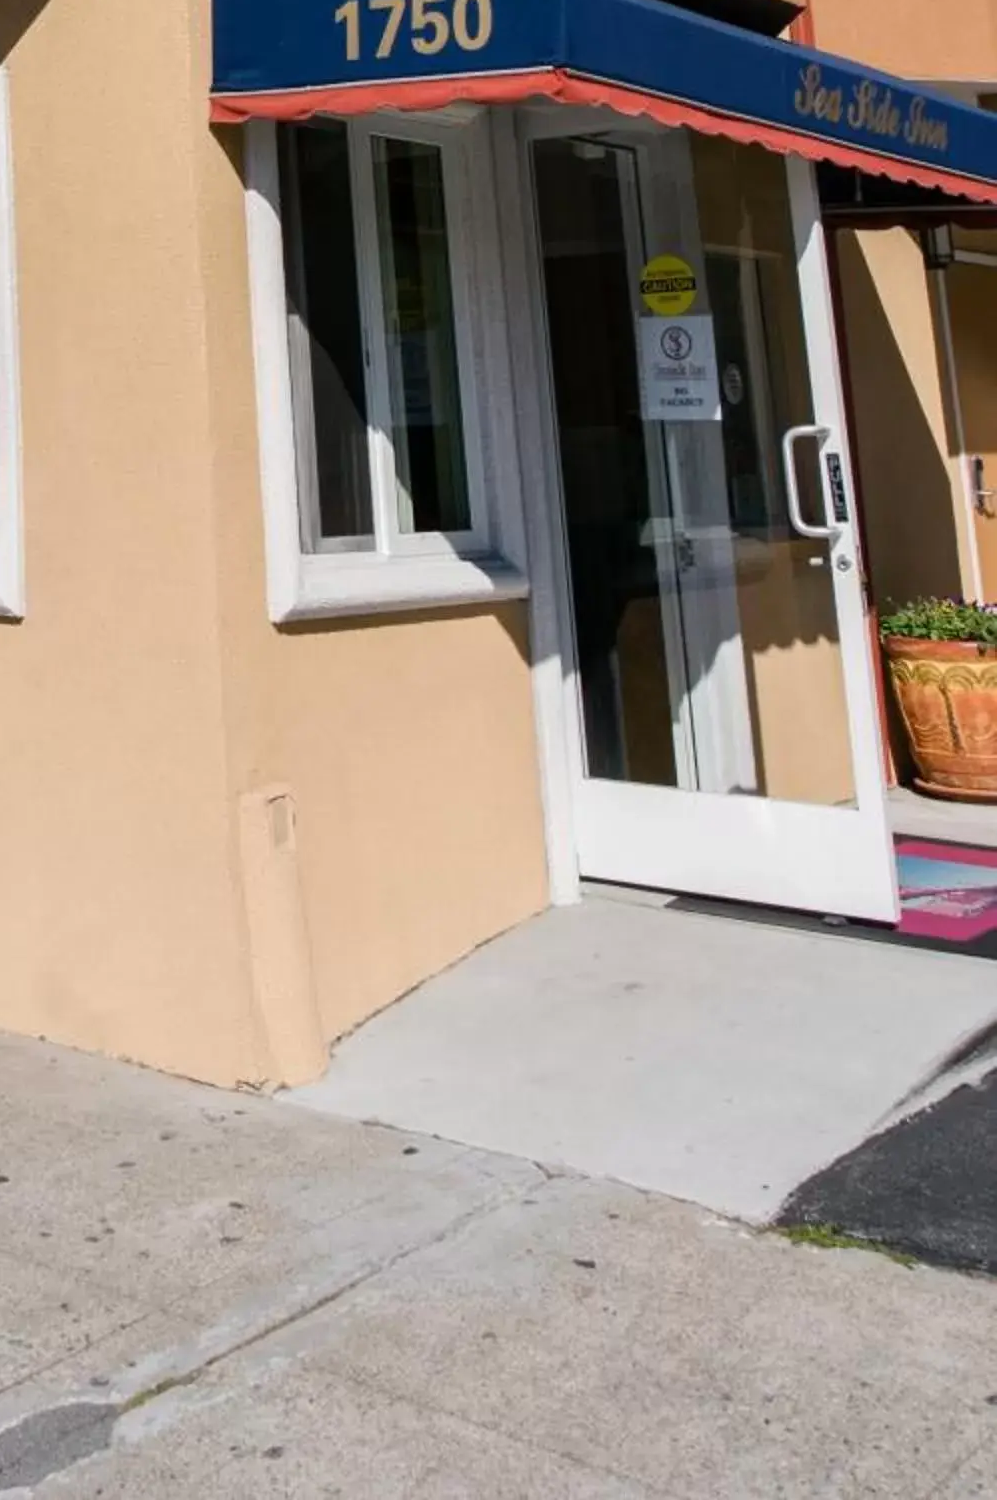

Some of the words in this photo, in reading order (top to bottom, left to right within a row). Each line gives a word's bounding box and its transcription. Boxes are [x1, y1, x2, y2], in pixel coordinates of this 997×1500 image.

[794, 64, 843, 124] Sea
[847, 79, 901, 137] Side
[904, 95, 949, 151] Inn
